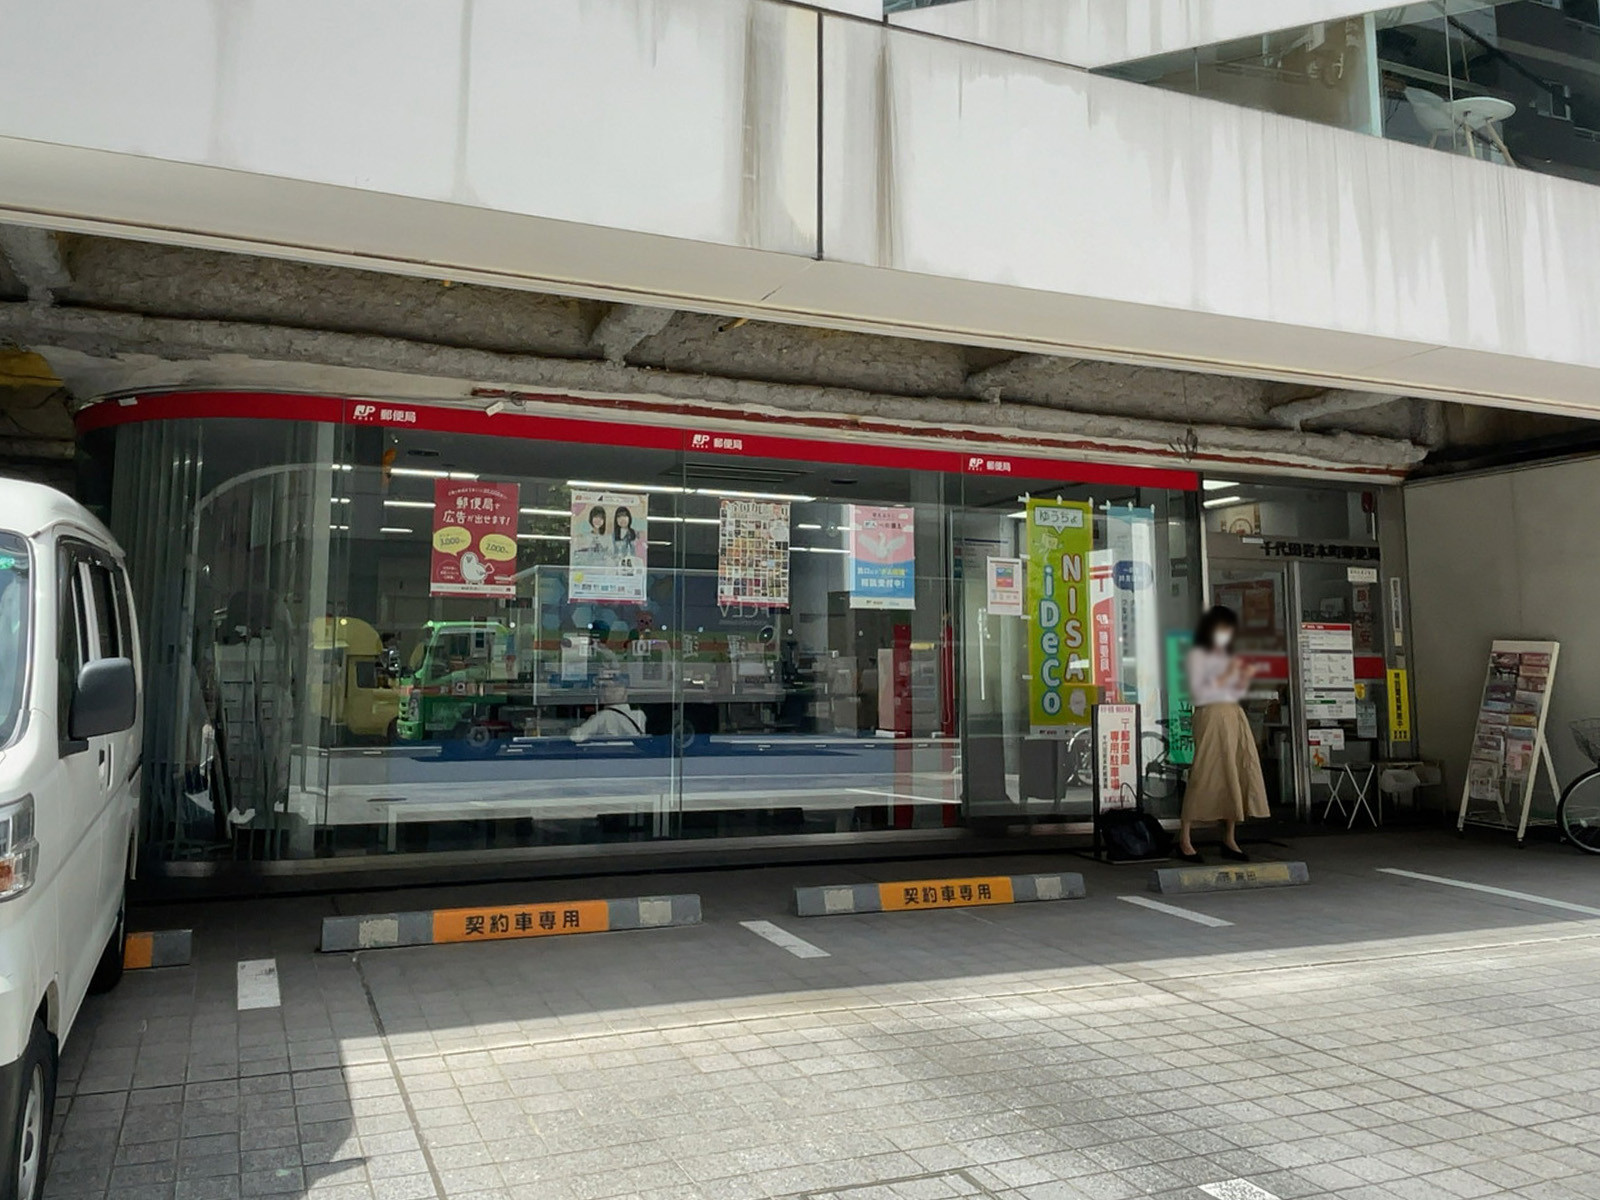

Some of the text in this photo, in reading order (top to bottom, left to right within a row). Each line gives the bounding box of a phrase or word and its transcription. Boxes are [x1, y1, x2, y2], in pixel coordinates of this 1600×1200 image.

[380, 408, 417, 423] 郵便局
[713, 437, 743, 450] 郵便局
[986, 460, 1011, 472] 郵便局
[1039, 509, 1077, 524] ゆうちょ
[1062, 553, 1084, 681] NISA
[1038, 565, 1061, 715] iDeCo
[904, 883, 991, 905] 契約車専用
[465, 910, 581, 935] 契約車専用
